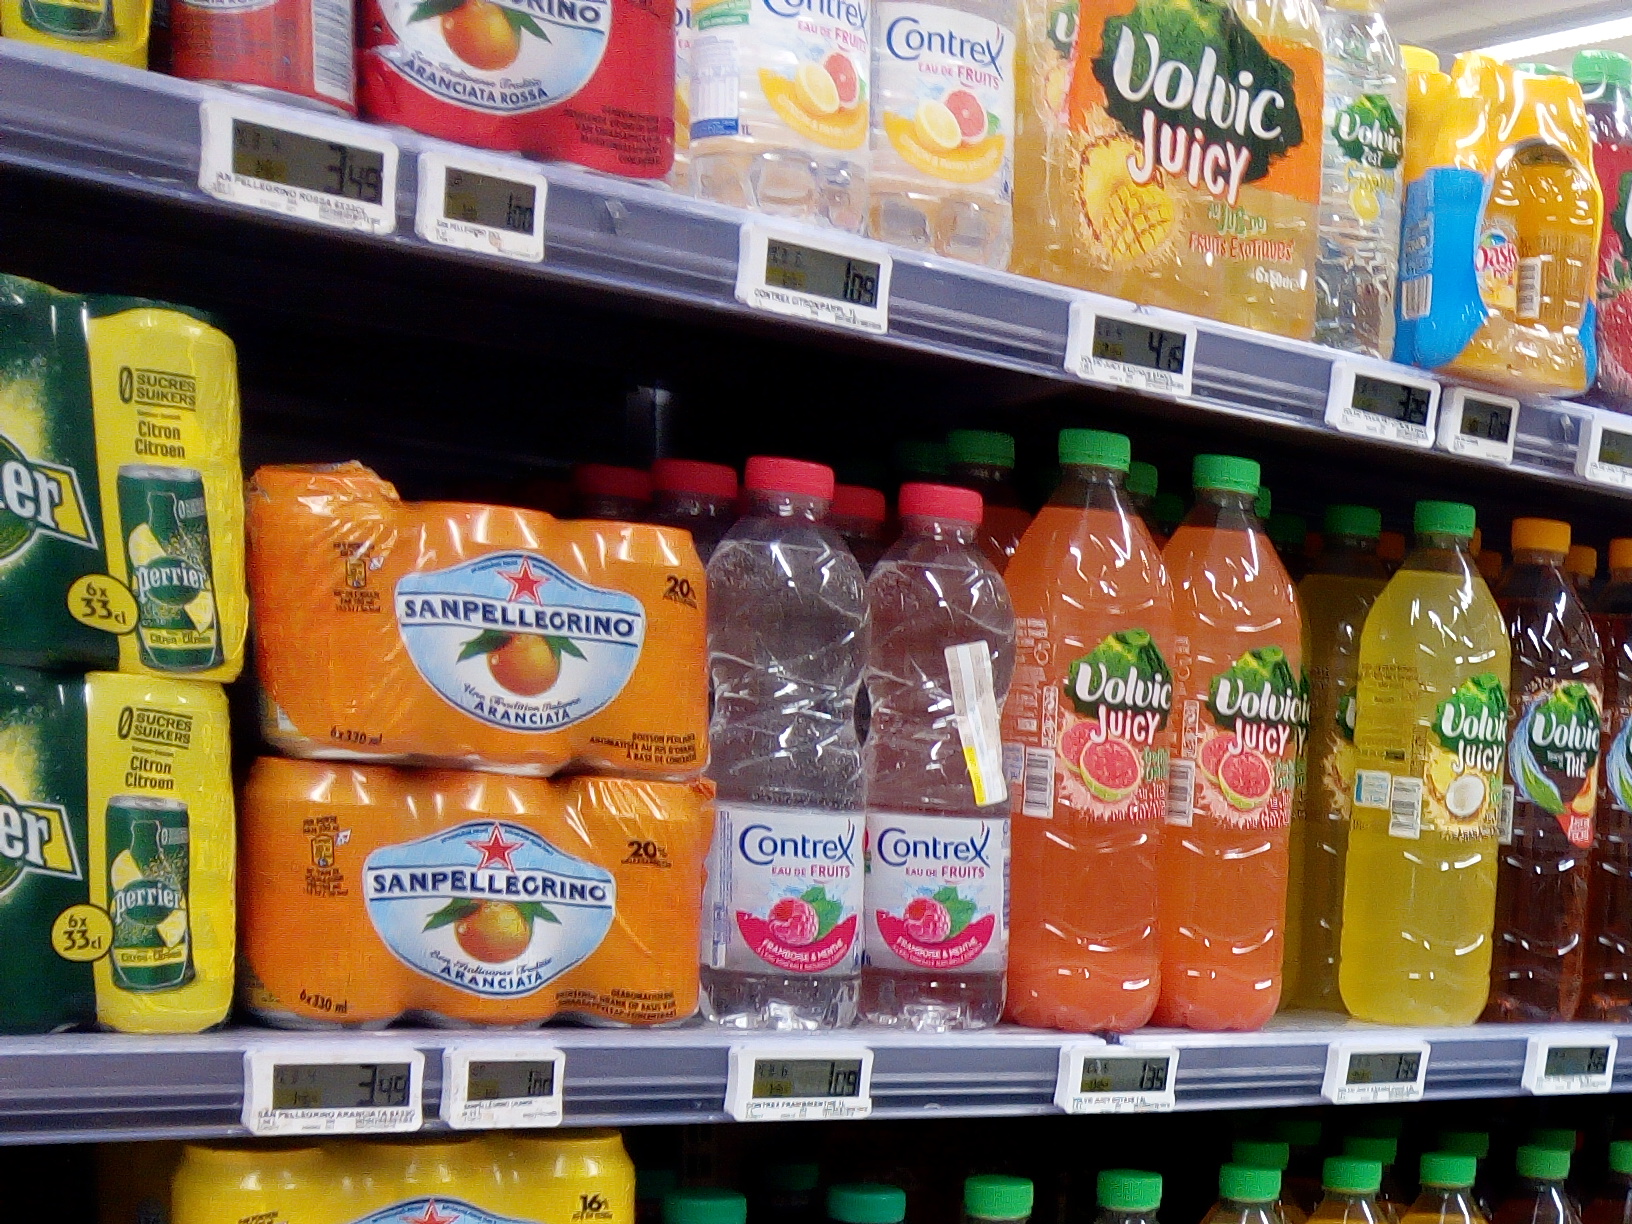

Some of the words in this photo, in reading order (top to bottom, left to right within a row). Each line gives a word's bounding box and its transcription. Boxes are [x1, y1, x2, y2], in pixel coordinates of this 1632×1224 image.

[402, 57, 497, 104] ARANCIATA
[500, 86, 549, 105] ROSSA
[957, 65, 1000, 90] FRUITS
[1113, 23, 1285, 140] Volvic
[136, 374, 196, 394] SUCRES
[136, 386, 196, 407] SUIKERS
[138, 420, 181, 441] Citron
[135, 438, 186, 459] Citroen
[136, 562, 208, 604] perrier
[404, 599, 636, 638] SANPELLEGRINO
[1075, 661, 1172, 710] Volvic
[1216, 678, 1299, 722] Volvic
[135, 712, 192, 732] SUCRES
[474, 700, 572, 726] ARANCIATA
[133, 723, 191, 745] SUIKERS
[130, 755, 172, 775] Citron
[771, 866, 791, 877] EAU
[810, 864, 851, 879] FRUITS
[905, 866, 923, 877] EAU
[941, 865, 985, 879] FRUITS
[372, 869, 607, 902] SANPELLEGRINO
[114, 883, 181, 924] perrier
[439, 964, 544, 990] ARANCIATA
